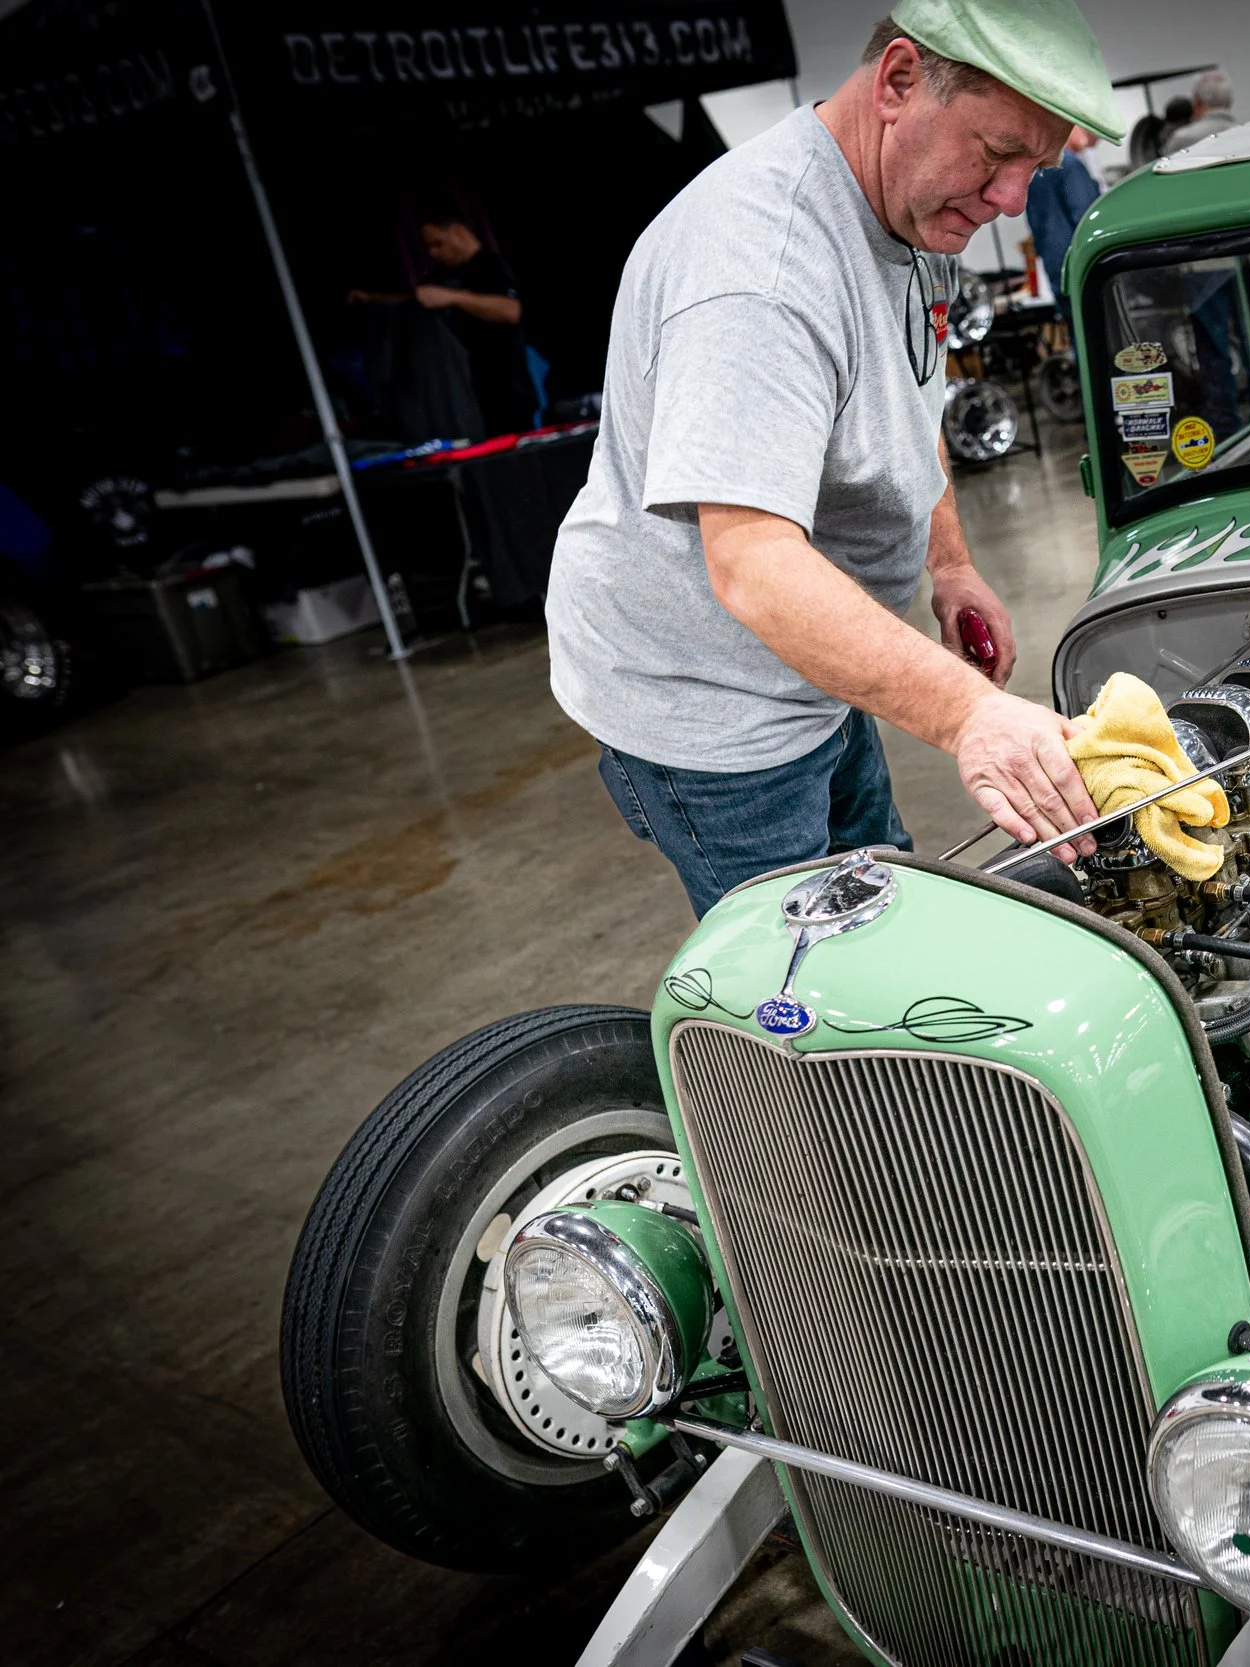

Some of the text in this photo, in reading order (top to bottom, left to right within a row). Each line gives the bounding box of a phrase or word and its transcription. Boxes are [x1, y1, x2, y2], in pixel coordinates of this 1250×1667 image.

[283, 18, 752, 85] DETROITLIFE313.COM
[760, 1003, 801, 1028] Ford
[383, 1217, 435, 1357] ROYAL
[434, 1089, 544, 1200] LAREDO
